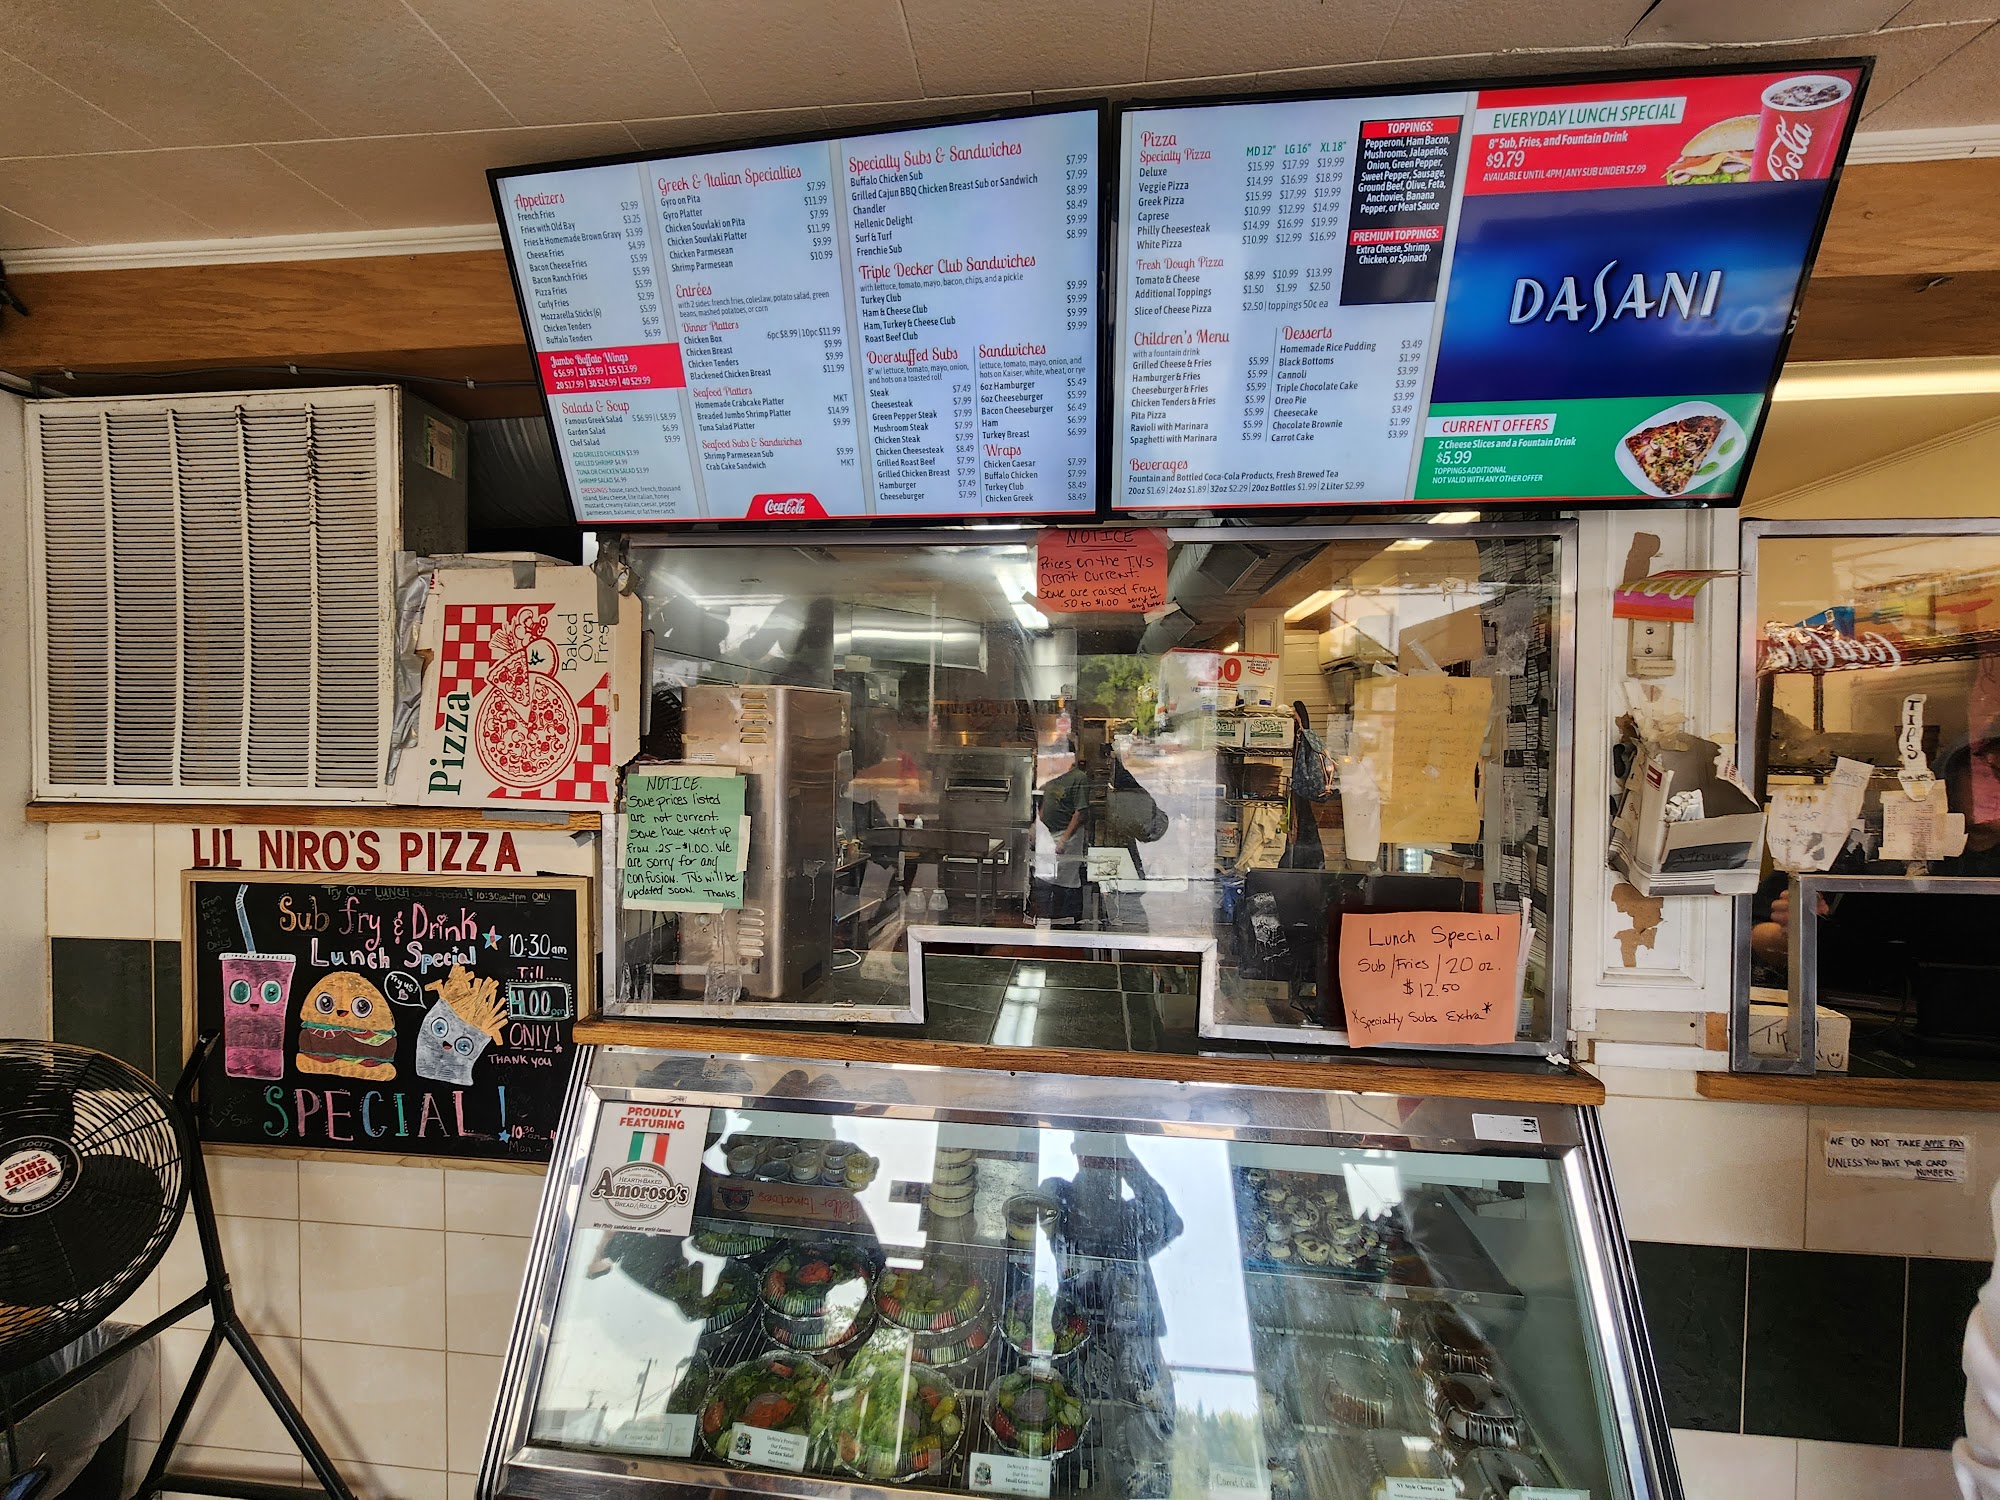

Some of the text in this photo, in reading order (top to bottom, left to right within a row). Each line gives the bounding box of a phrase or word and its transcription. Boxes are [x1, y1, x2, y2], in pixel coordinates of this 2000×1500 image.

[1493, 104, 1677, 129] EVERYDAY LUNCH SPECIAL
[1388, 122, 1433, 134] TOPPINGS:
[1140, 130, 1177, 148] Pizza
[1499, 136, 1516, 149] Sub,
[1519, 135, 1541, 148] Fries,
[1543, 135, 1560, 146] and
[1562, 133, 1602, 145] Fountain
[1603, 130, 1628, 142] Drink
[1767, 115, 1812, 181] Cola
[849, 142, 1022, 175] Specialty Subs & Sandwiches
[1486, 150, 1525, 169] $9.79
[850, 154, 1088, 187] Buffalo Chicken Sub $7.99
[1139, 157, 1345, 177] Deluxe $15.99 $17.99 $19.99
[658, 166, 802, 197] Greek & Italian Specialties
[514, 193, 565, 210] Appetizers
[859, 254, 1036, 283] Triple Decker Club Sandwiches
[676, 284, 712, 299] Entrées
[1509, 260, 1722, 333] DASANI
[1134, 330, 1230, 347] Children's Menu
[1282, 326, 1332, 340] Desserts
[867, 347, 958, 366] Overstuffed Subs
[979, 343, 1046, 359] Sandwiches
[1277, 366, 1419, 380] Cannoli $3.99
[1442, 418, 1548, 434] CURRENT OFFERS
[1439, 441, 1444, 449] 2
[1445, 440, 1471, 449] Cheese
[1472, 439, 1494, 448] Slices
[1496, 439, 1510, 447] and
[1518, 438, 1552, 447] Fountain
[1553, 436, 1576, 446] Drink
[983, 444, 1022, 459] Wraps
[1436, 451, 1472, 465] $5.99
[1129, 458, 1188, 474] Beverages
[1066, 530, 1134, 545] NOTICE
[1040, 557, 1072, 569] Prices
[1077, 558, 1093, 568] on
[1097, 556, 1119, 567] the
[1039, 584, 1157, 599] Some are raised from
[1061, 599, 1077, 608] .50
[557, 613, 609, 671] Baked Oven Fres
[1906, 700, 1921, 760] TIPS
[428, 692, 471, 796] Pizza
[628, 794, 720, 811] Some prices listed
[631, 811, 719, 823] are not current.
[629, 826, 731, 839] Some have went up
[192, 828, 521, 872] LIL NIRO'S PIZZA
[627, 843, 649, 853] from
[656, 844, 673, 853] .25
[715, 841, 732, 852] We
[627, 855, 718, 871] are sorry for any
[627, 872, 678, 883] confusion.
[705, 870, 723, 882] will
[726, 873, 739, 881] be
[628, 885, 662, 899] updated
[278, 892, 330, 932] Sub
[338, 895, 381, 950] fry
[411, 903, 477, 941] Drink
[1369, 926, 1500, 948] Lunch Special
[310, 938, 477, 974] Lunch Special
[1358, 959, 1385, 973] Sub
[1408, 1012, 1437, 1023] Subs
[488, 1054, 552, 1068] THANK you
[627, 1107, 681, 1118] PROUDLY
[620, 1117, 685, 1129] FEATURING
[1830, 1137, 1844, 1146] WE
[1851, 1138, 1865, 1147] DO
[1871, 1139, 1889, 1147] NOT
[5, 1158, 47, 1179] SHOP
[1827, 1158, 1863, 1168] UNLESS
[1865, 1159, 1880, 1167] YOU
[4, 1163, 56, 1189] THRIFT
[1916, 1168, 1954, 1177] NUMBERS
[592, 1169, 687, 1201] Amoroso's
